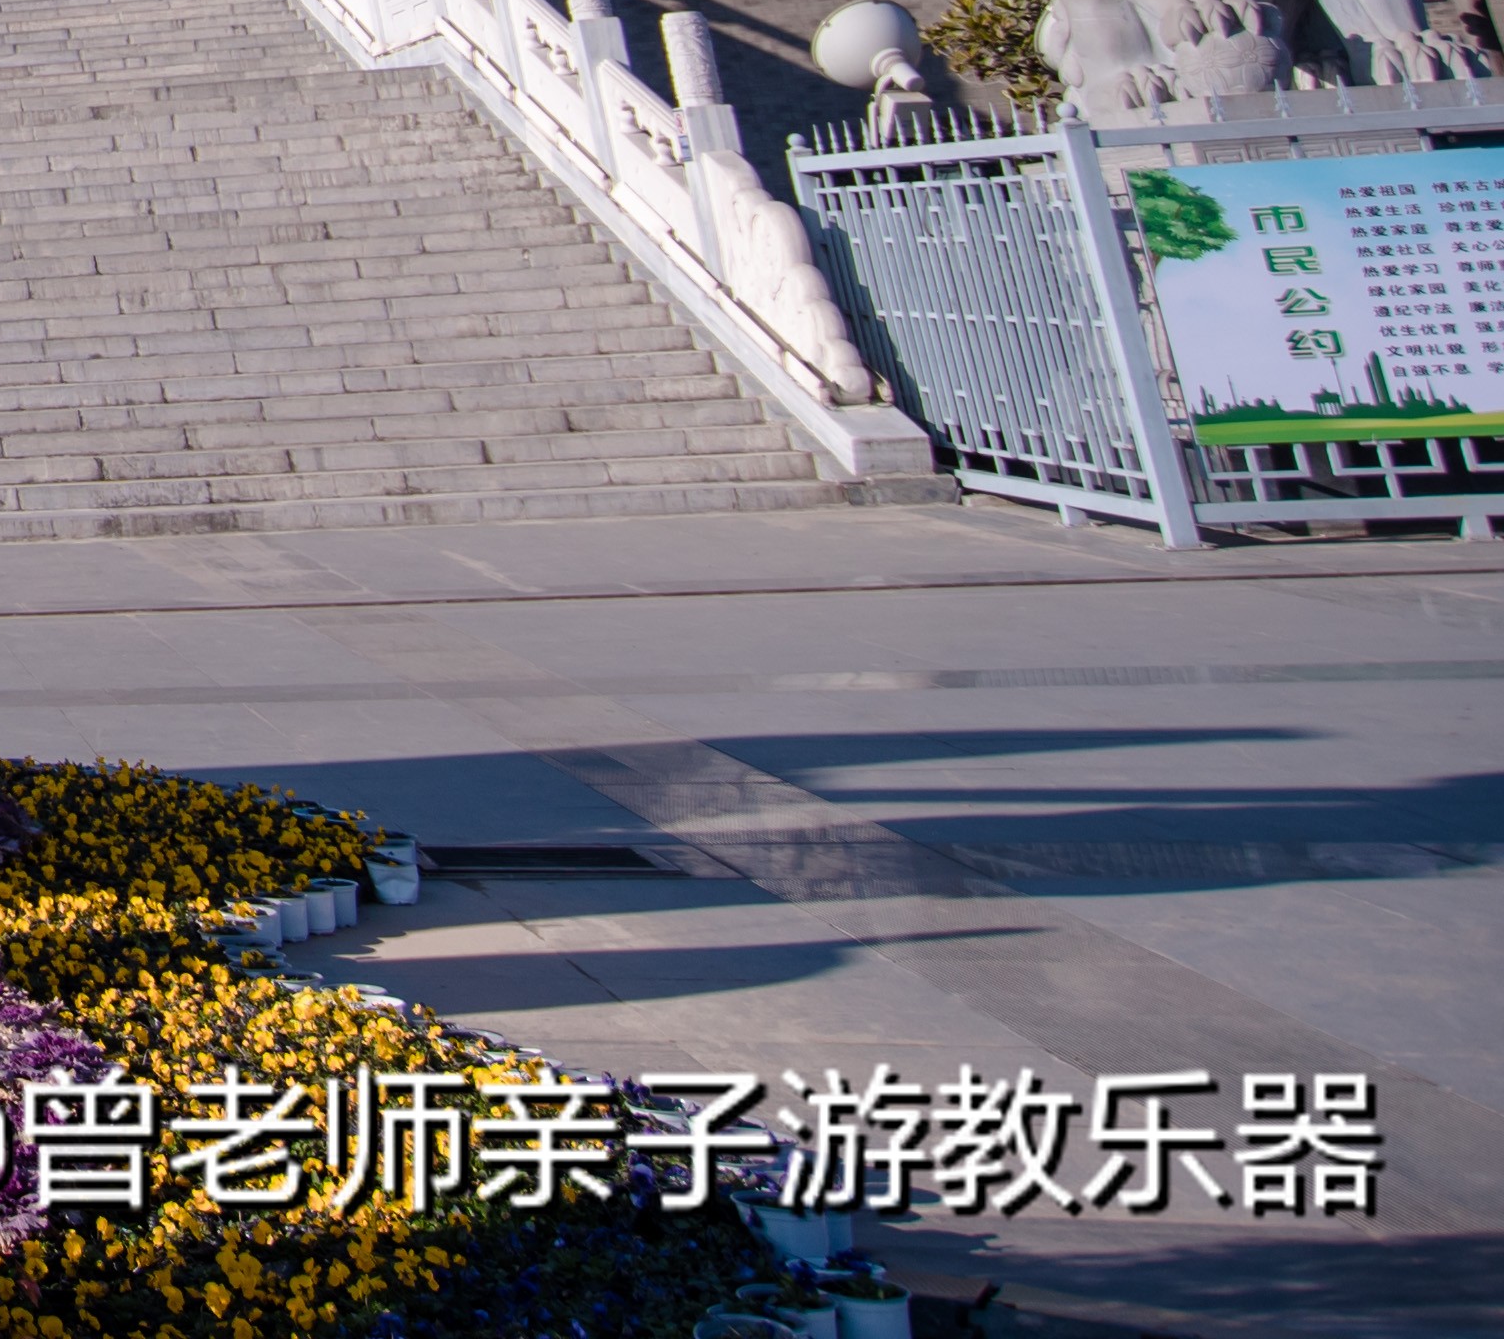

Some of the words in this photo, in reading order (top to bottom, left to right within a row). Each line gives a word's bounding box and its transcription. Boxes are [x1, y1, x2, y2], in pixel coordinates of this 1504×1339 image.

[1339, 184, 1416, 199] 热爱祖国
[1345, 204, 1422, 219] 热爱生活
[1438, 199, 1504, 214] 珍惜生
[1351, 223, 1428, 239] 热爱家庭
[1356, 243, 1435, 258] 热爱社区
[1362, 263, 1440, 278] 热爱学习
[1249, 205, 1345, 359] 市民公约
[1368, 283, 1446, 298] 绿化家园
[1374, 303, 1454, 318] 遵纪守法
[1379, 323, 1459, 338] 优生优育
[1385, 343, 1466, 357] 文明礼貌
[1392, 363, 1471, 378] 自强不息
